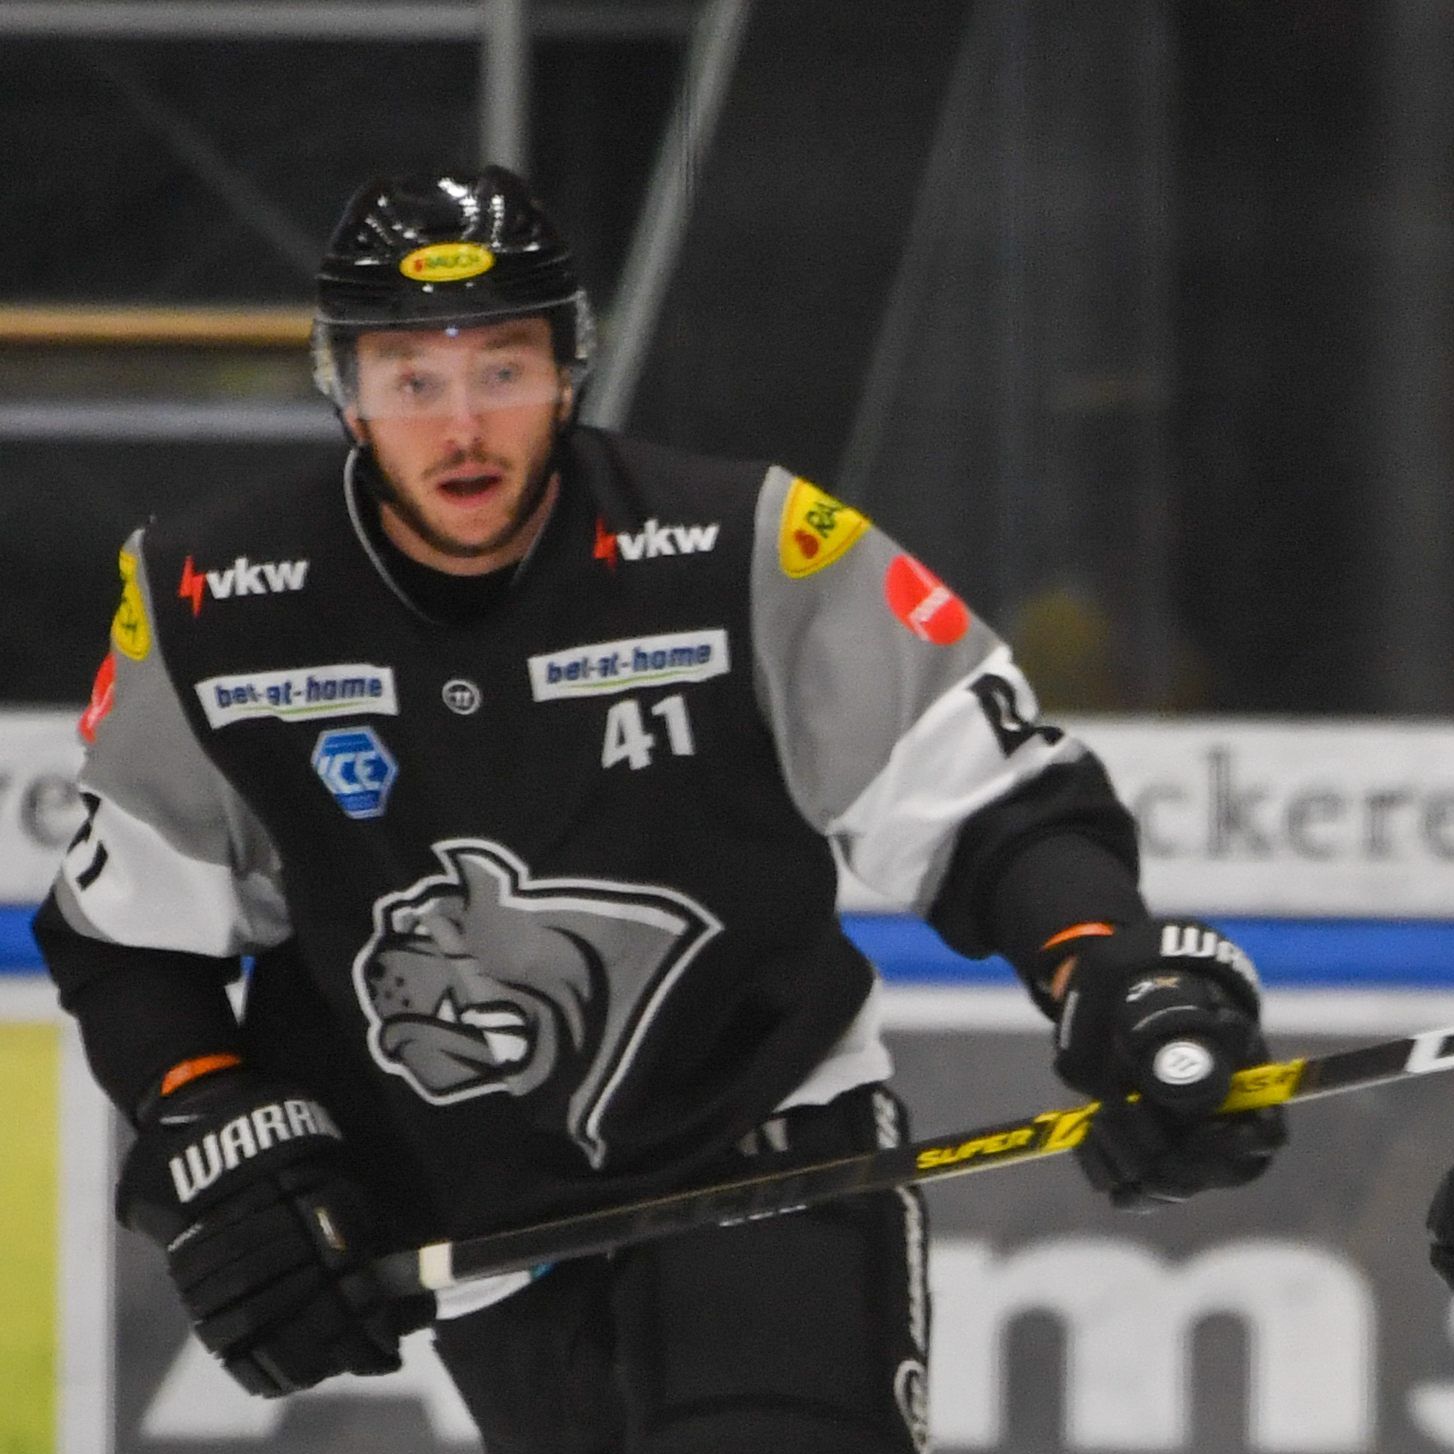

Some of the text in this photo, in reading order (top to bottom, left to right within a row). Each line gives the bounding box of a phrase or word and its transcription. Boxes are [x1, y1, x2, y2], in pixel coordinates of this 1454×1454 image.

[617, 517, 720, 561] vkw
[206, 556, 310, 600] vkw
[546, 643, 712, 685] bet-at-home
[215, 675, 383, 709] bet-at-home
[601, 694, 698, 771] 41
[316, 750, 384, 794] ICE
